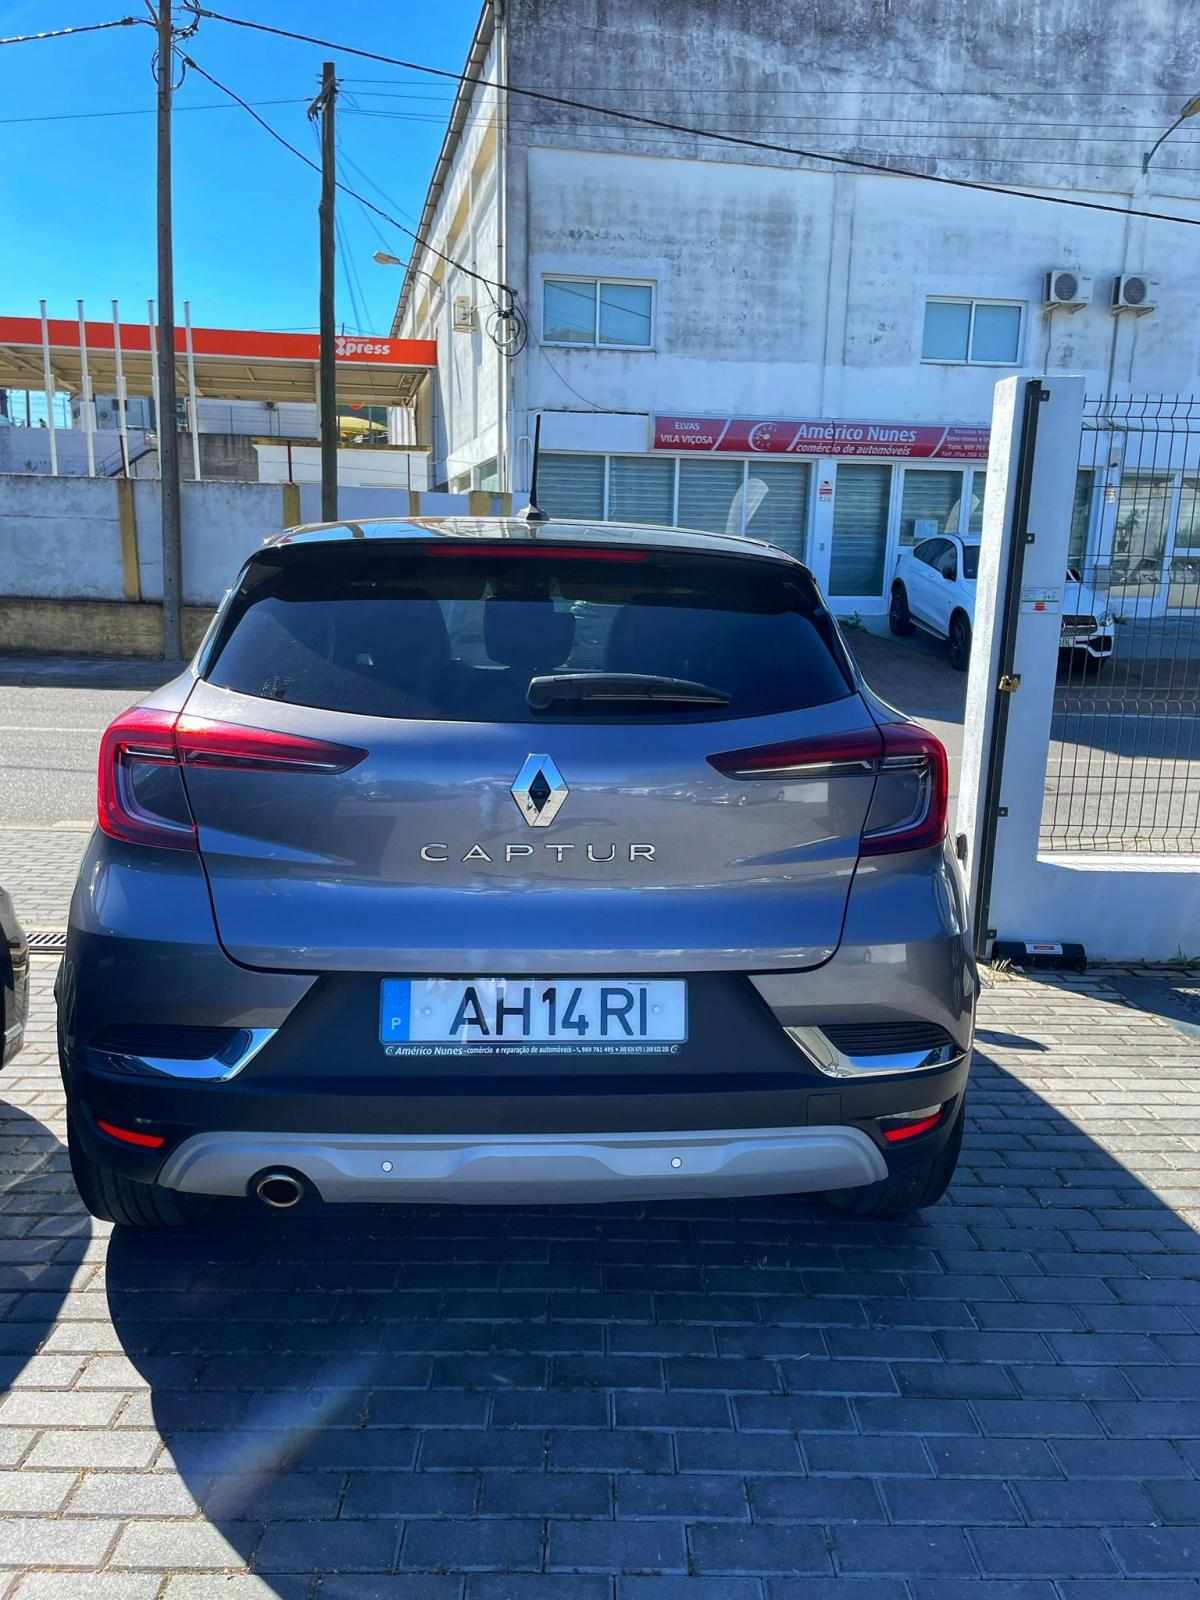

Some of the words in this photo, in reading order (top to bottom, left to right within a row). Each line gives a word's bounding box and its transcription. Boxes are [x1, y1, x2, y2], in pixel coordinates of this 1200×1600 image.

[674, 421, 701, 431] ELVAS
[798, 423, 864, 441] Américo
[866, 426, 918, 443] Nunes
[660, 433, 681, 443] VILA
[682, 434, 713, 445] VIÇOSA
[796, 442, 841, 453] comércio
[842, 444, 855, 455] de
[856, 444, 912, 456] automóveis
[420, 843, 657, 862] CAPTUR
[390, 1017, 402, 1031] P
[394, 1046, 433, 1056] Américo
[434, 1046, 463, 1056] Nunes
